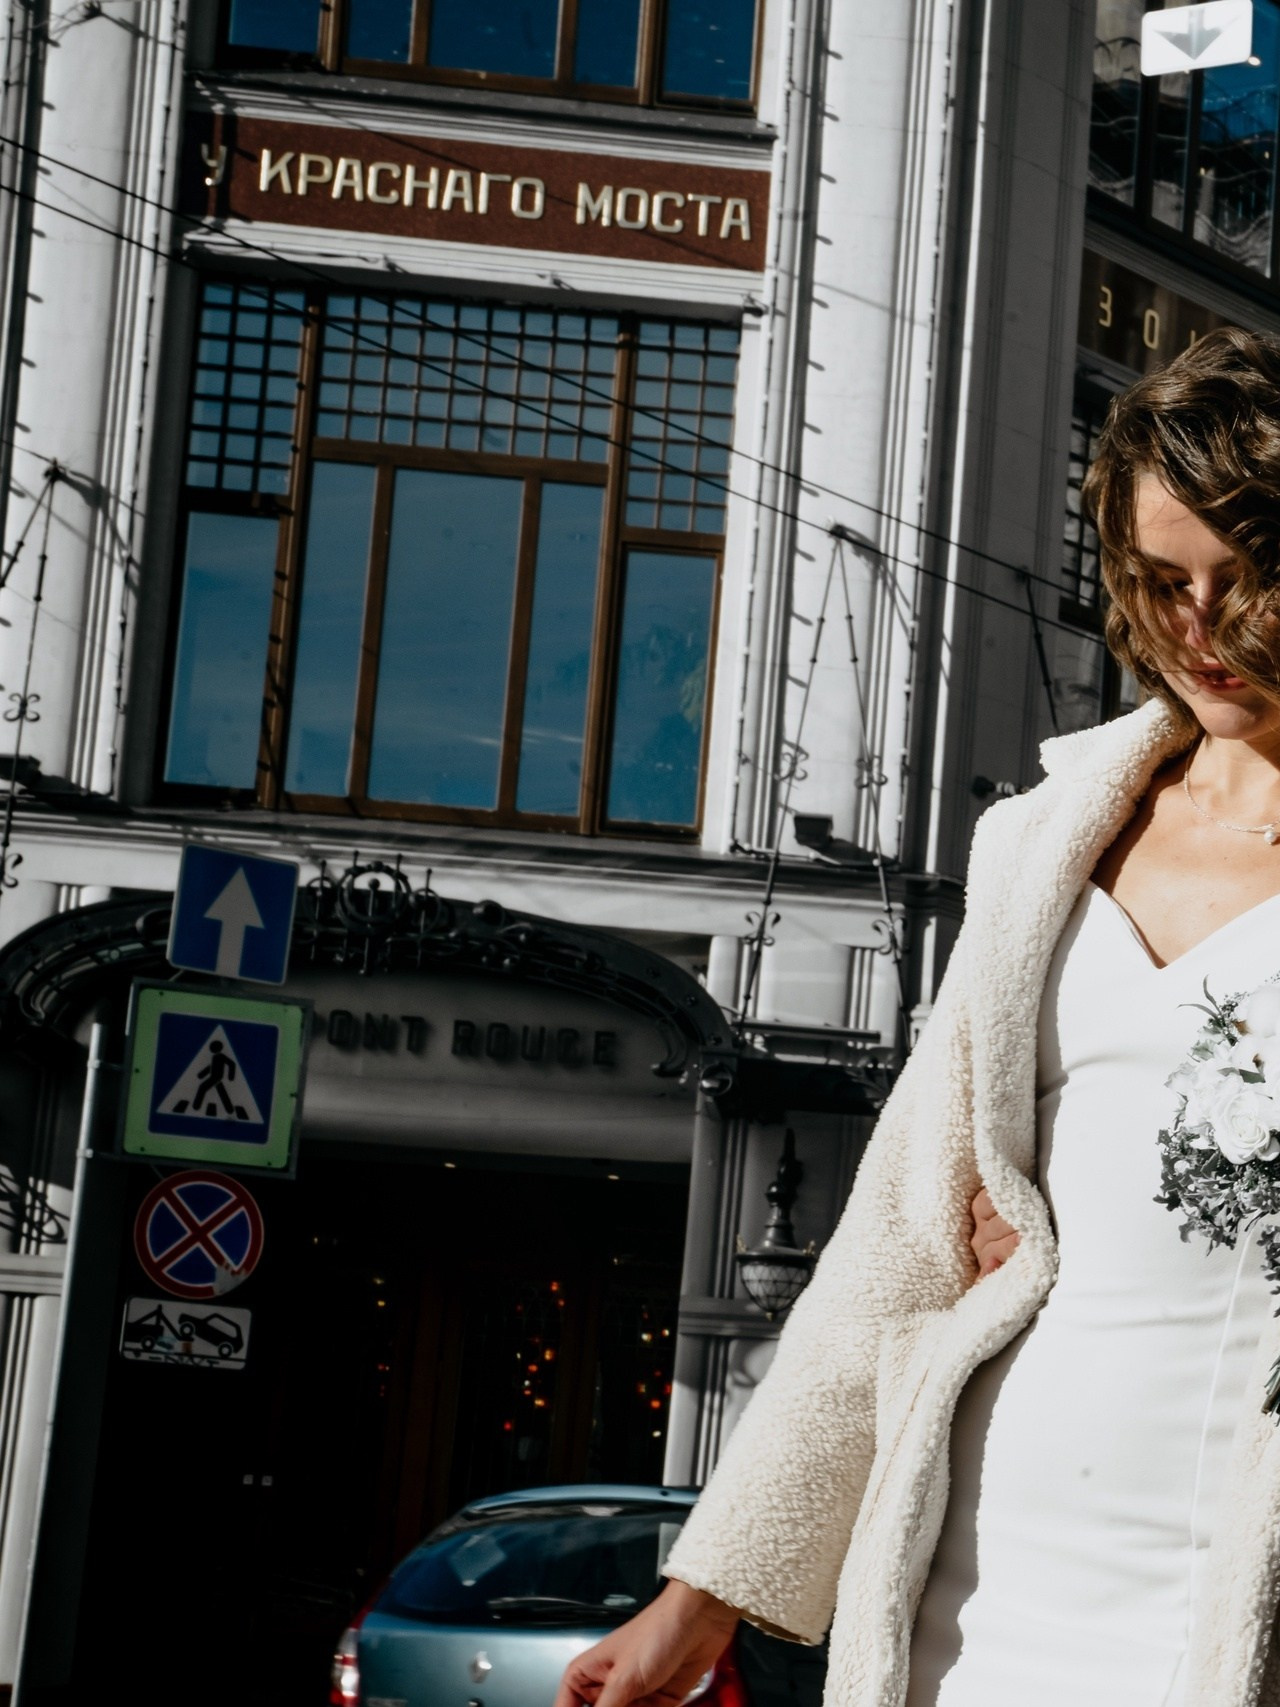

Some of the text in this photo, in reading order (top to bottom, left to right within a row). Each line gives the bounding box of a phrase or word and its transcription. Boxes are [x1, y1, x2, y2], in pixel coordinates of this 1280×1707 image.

[260, 149, 545, 219] КРАСНАГО
[576, 182, 752, 240] МОСТА
[326, 1010, 426, 1054] ONT
